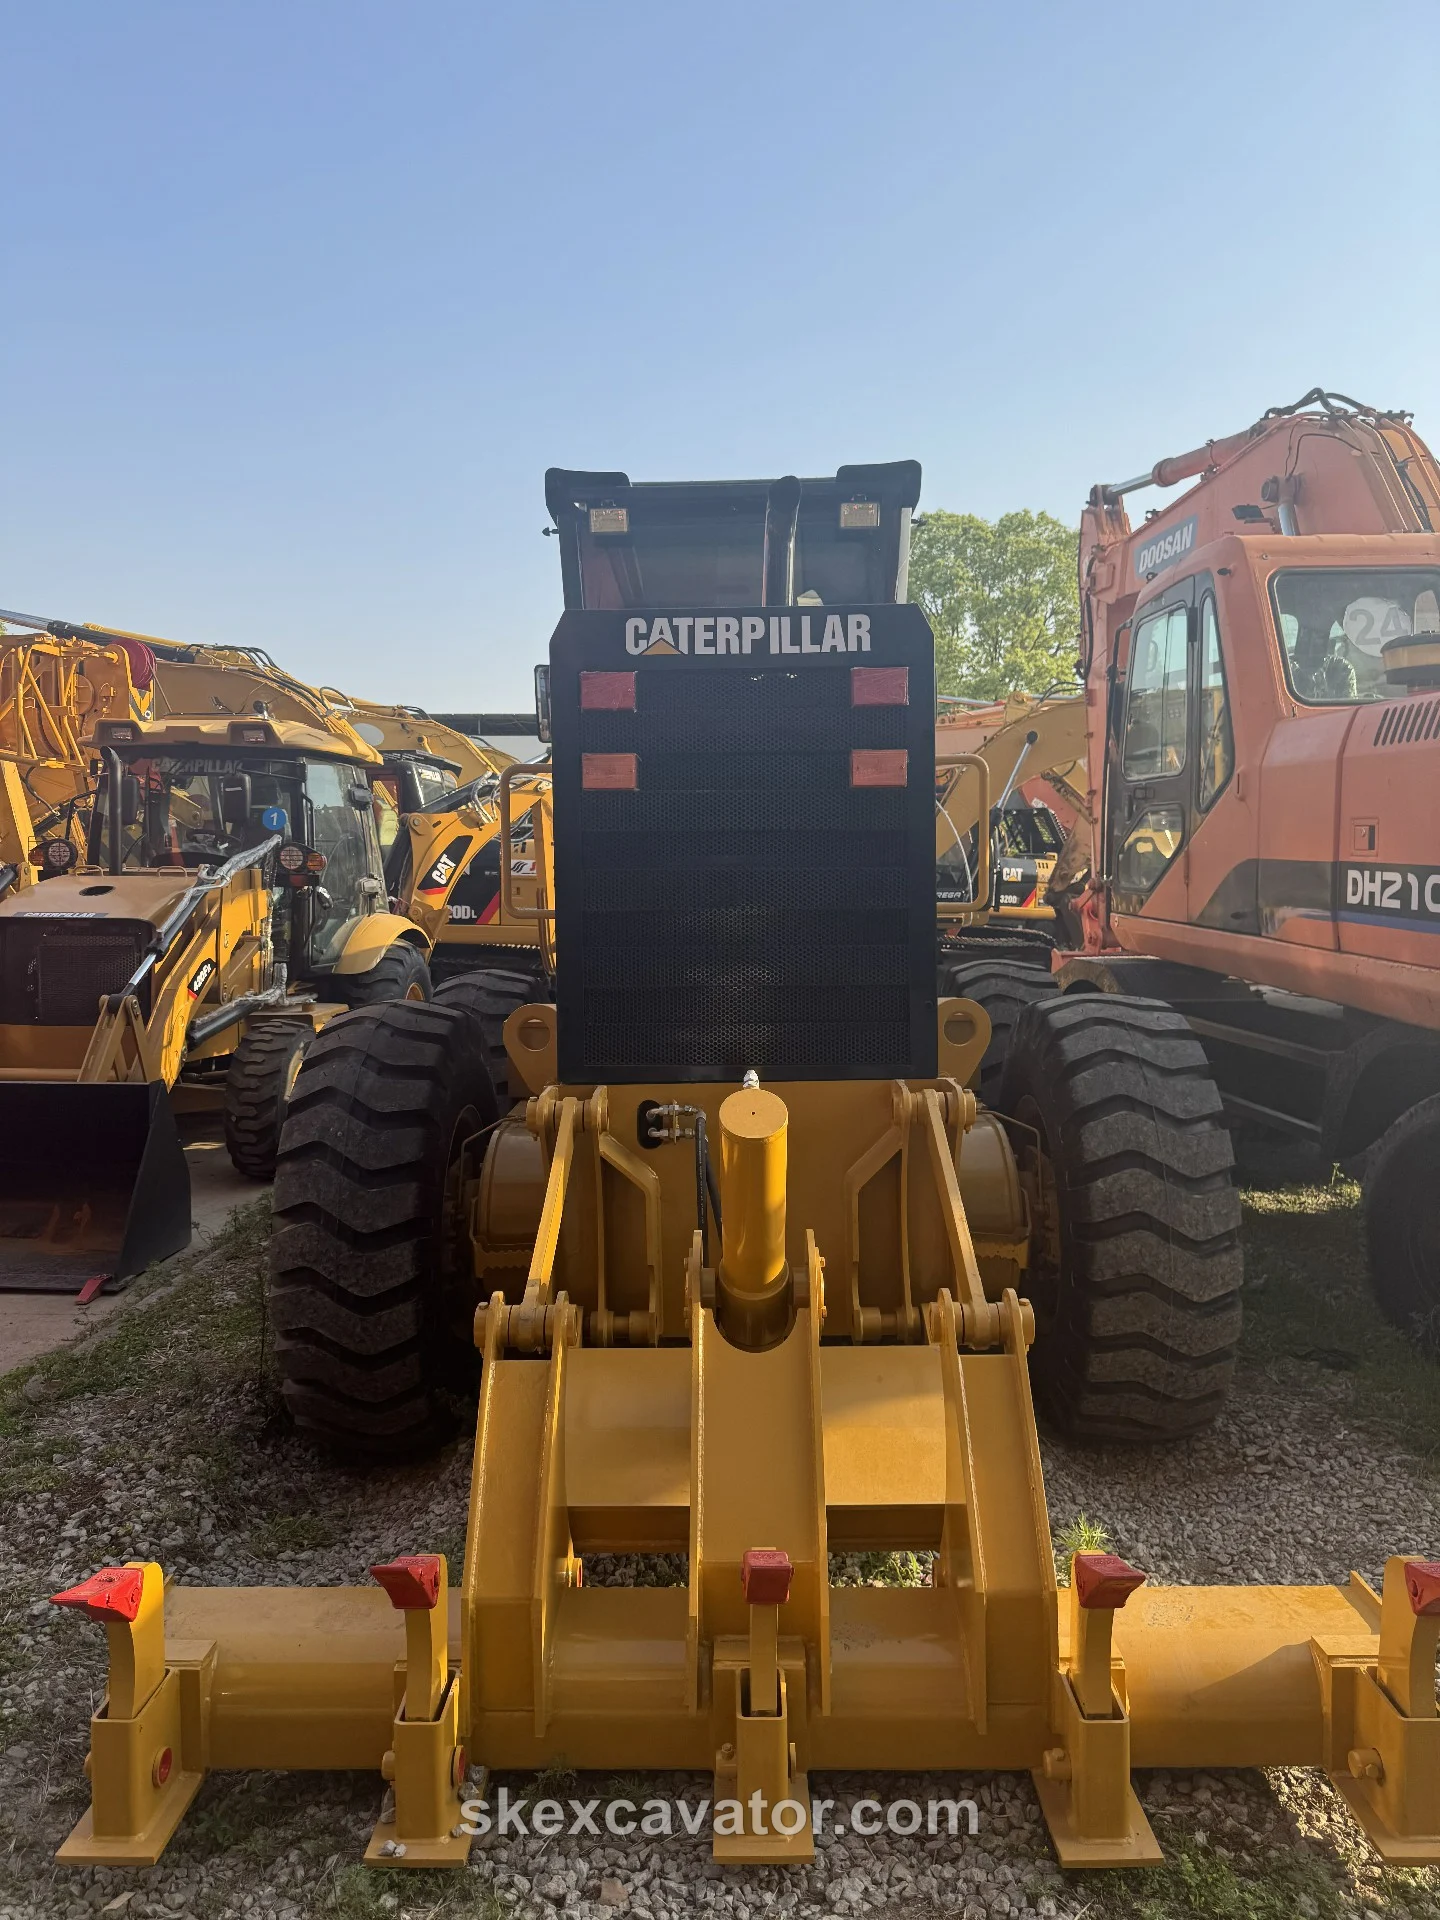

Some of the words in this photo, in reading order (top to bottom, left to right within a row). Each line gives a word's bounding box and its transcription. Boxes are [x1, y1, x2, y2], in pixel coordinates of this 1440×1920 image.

[1138, 522, 1194, 574] DOOSAN
[625, 613, 872, 656] CATERPILLAR
[1348, 607, 1409, 646] 24
[270, 812, 278, 826] 1
[431, 853, 457, 885] CAT
[1002, 867, 1024, 882] CAT
[1000, 894, 1018, 904] 320D
